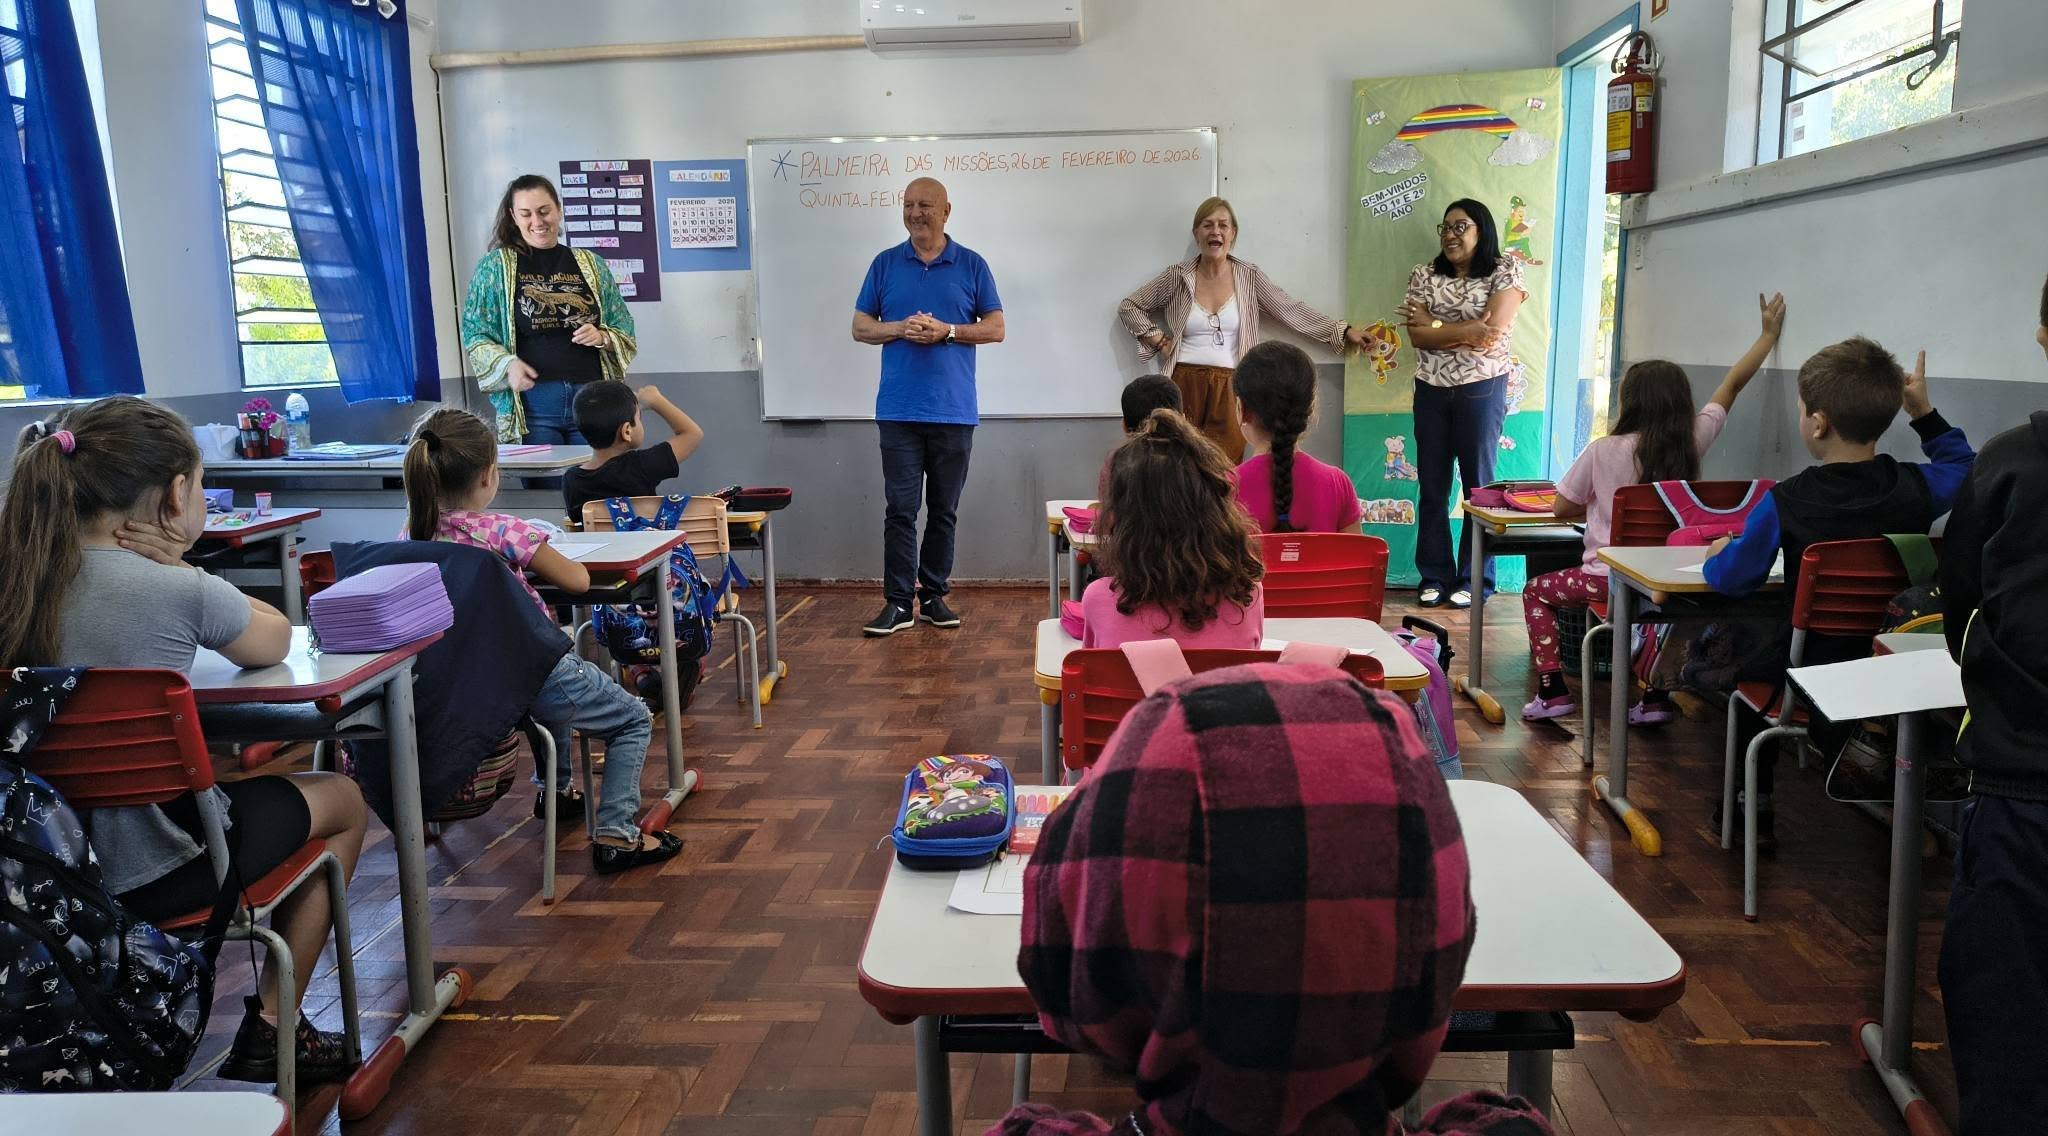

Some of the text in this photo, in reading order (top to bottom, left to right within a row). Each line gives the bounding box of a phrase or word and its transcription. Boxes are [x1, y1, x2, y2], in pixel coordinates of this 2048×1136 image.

[800, 151, 890, 178] PALMEIRA
[905, 153, 932, 173] DAS
[1062, 150, 1136, 168] FEVEREIRO
[1143, 149, 1161, 164] DE
[800, 188, 905, 208] QUINTA-FEIR
[1361, 172, 1427, 208] BEM-VINDOS
[1373, 203, 1388, 216] AO
[1403, 193, 1411, 203] E
[1390, 204, 1413, 220] ANO
[519, 271, 583, 283] WILD JAGUAR
